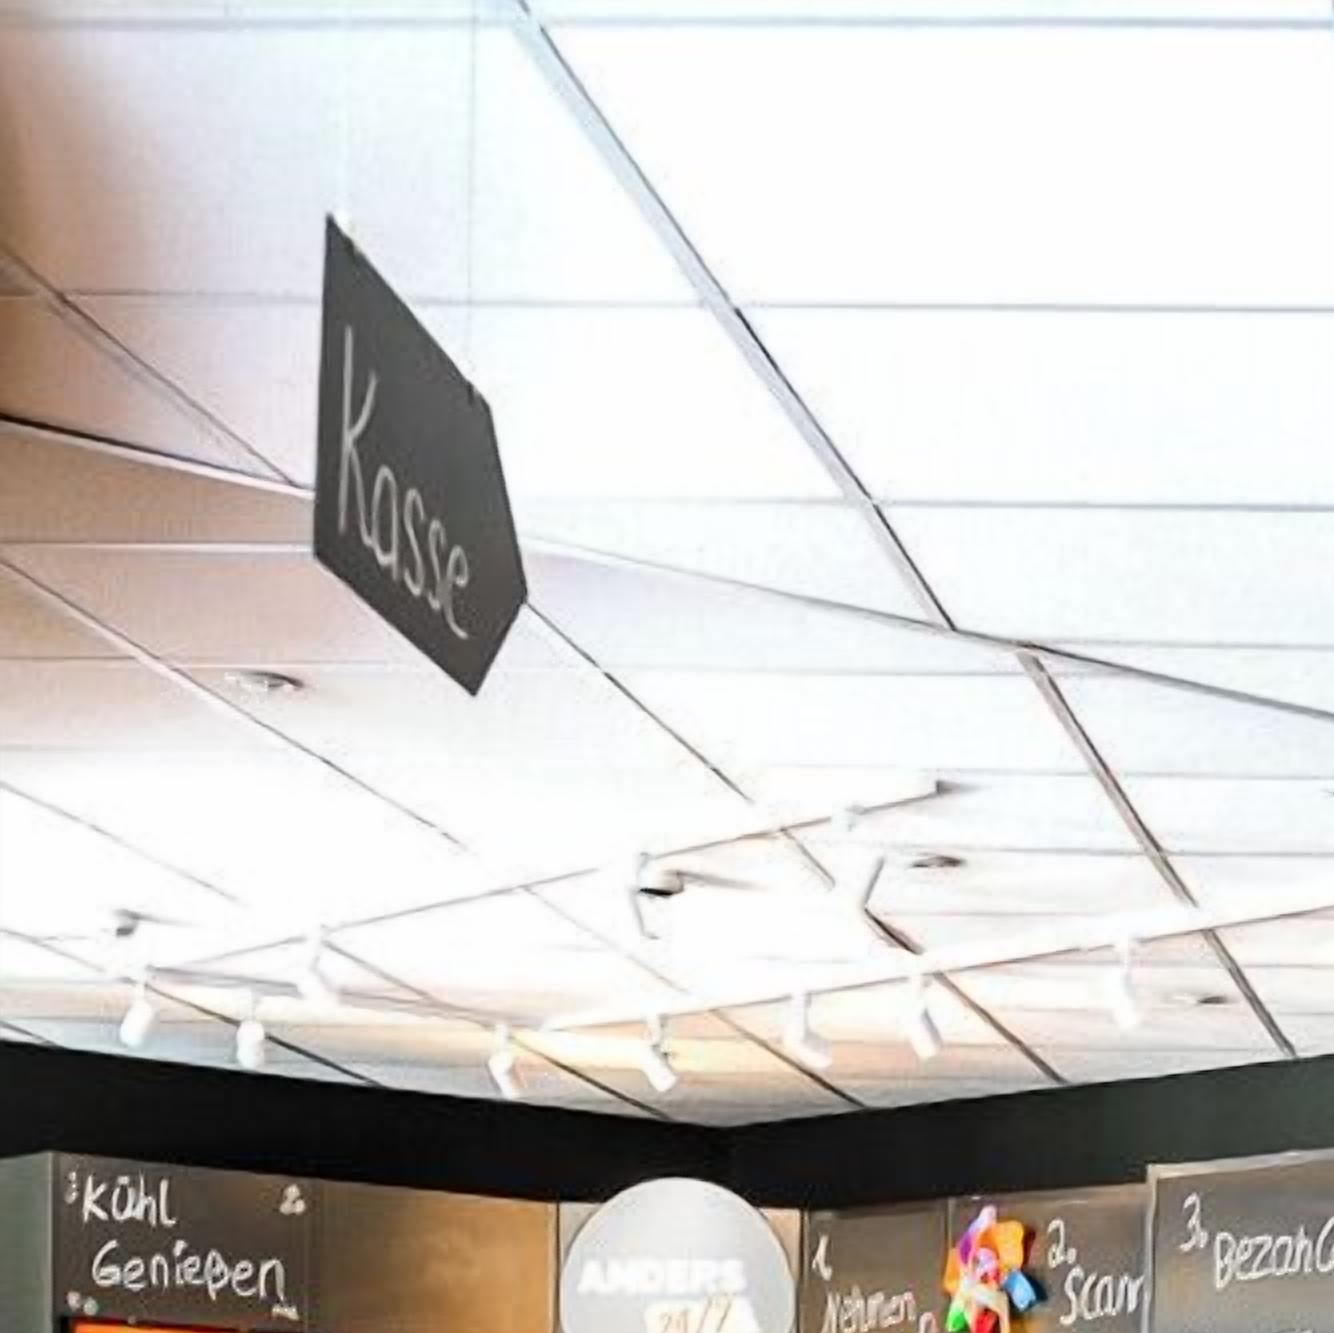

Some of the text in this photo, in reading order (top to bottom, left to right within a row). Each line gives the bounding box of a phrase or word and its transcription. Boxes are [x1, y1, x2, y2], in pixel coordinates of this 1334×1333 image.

[338, 325, 470, 640] Kasse
[81, 1175, 176, 1228] Kühl
[91, 1239, 287, 1300] Genießen
[576, 1257, 750, 1297] ANDERS
